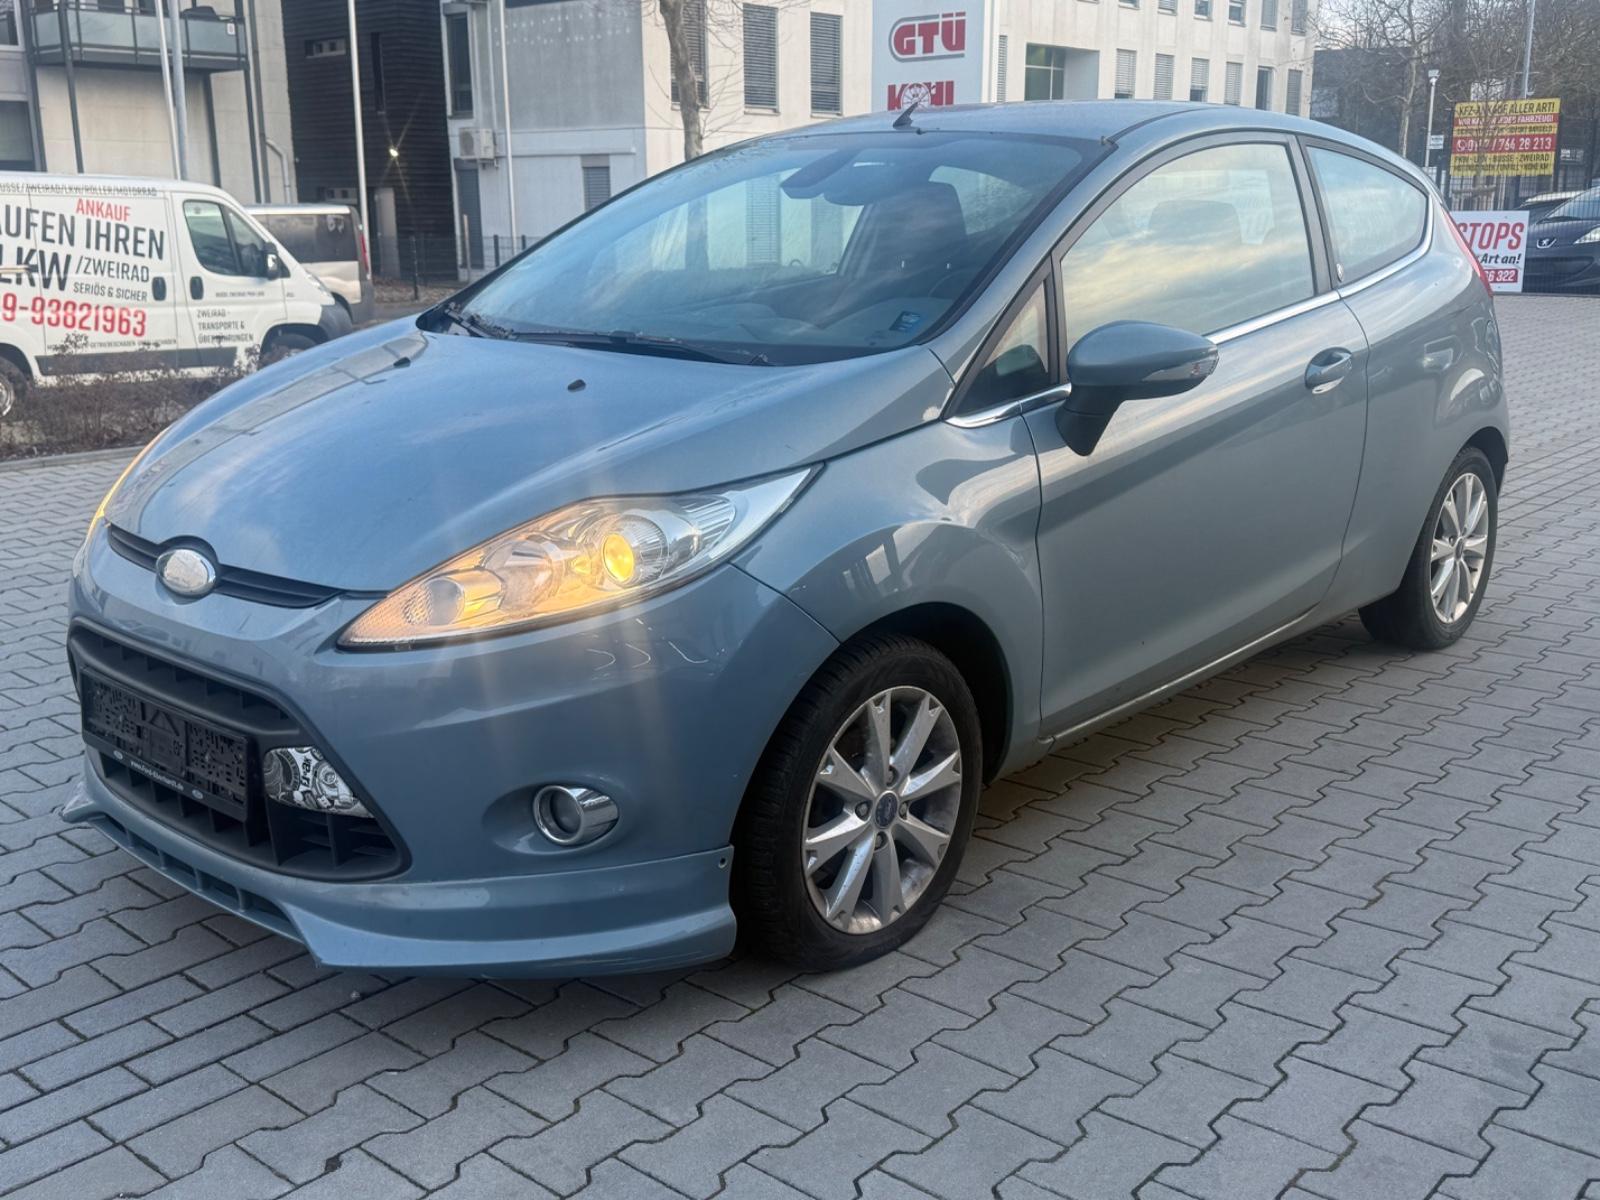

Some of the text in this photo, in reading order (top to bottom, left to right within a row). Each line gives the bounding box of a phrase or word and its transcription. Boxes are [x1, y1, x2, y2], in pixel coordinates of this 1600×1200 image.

[893, 11, 966, 56] GTÜ
[1535, 101, 1555, 112] ART!
[1533, 137, 1552, 150] 213
[76, 198, 131, 222] ANKAUF
[0, 204, 165, 260] UFEN IHREN
[1480, 252, 1500, 264] Art
[1501, 252, 1522, 264] an!
[1496, 269, 1517, 282] 322
[73, 281, 148, 302] SERIÖS & SICHER
[2, 292, 146, 338] 9-93821963
